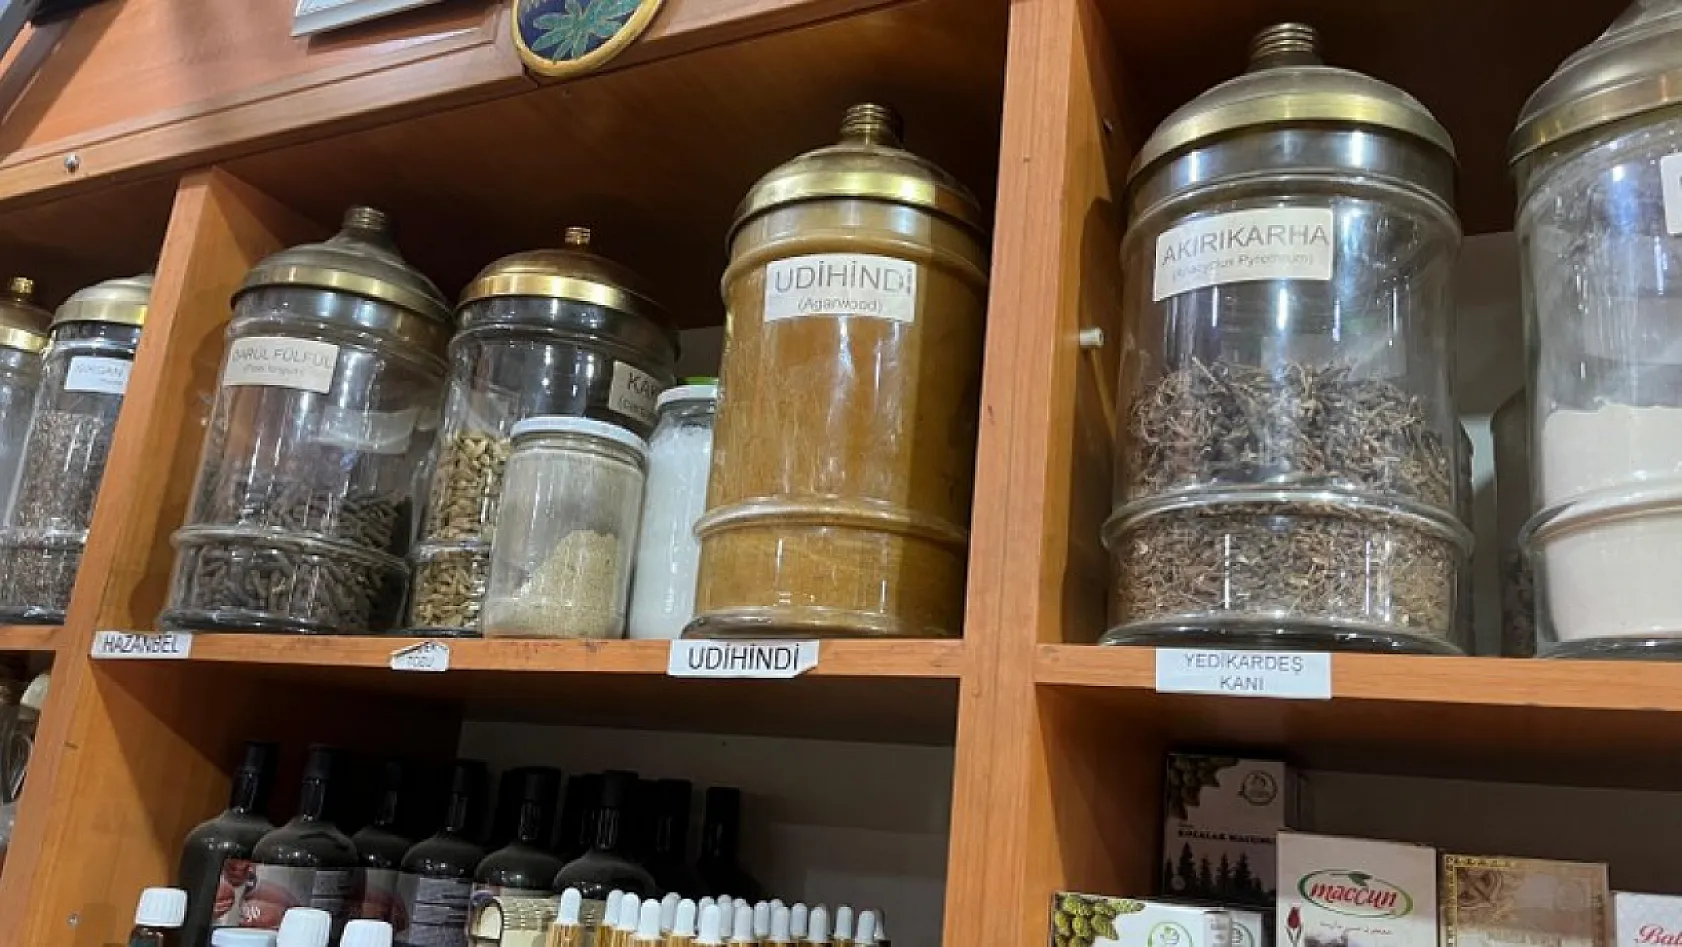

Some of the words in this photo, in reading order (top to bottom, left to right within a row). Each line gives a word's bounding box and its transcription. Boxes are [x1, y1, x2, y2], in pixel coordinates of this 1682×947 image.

[1162, 224, 1330, 266] AKIRIKARHA
[774, 260, 913, 295] UDİHİNDİ
[797, 296, 884, 314] (Agarwood)
[688, 642, 799, 671] UDİHİNDİ
